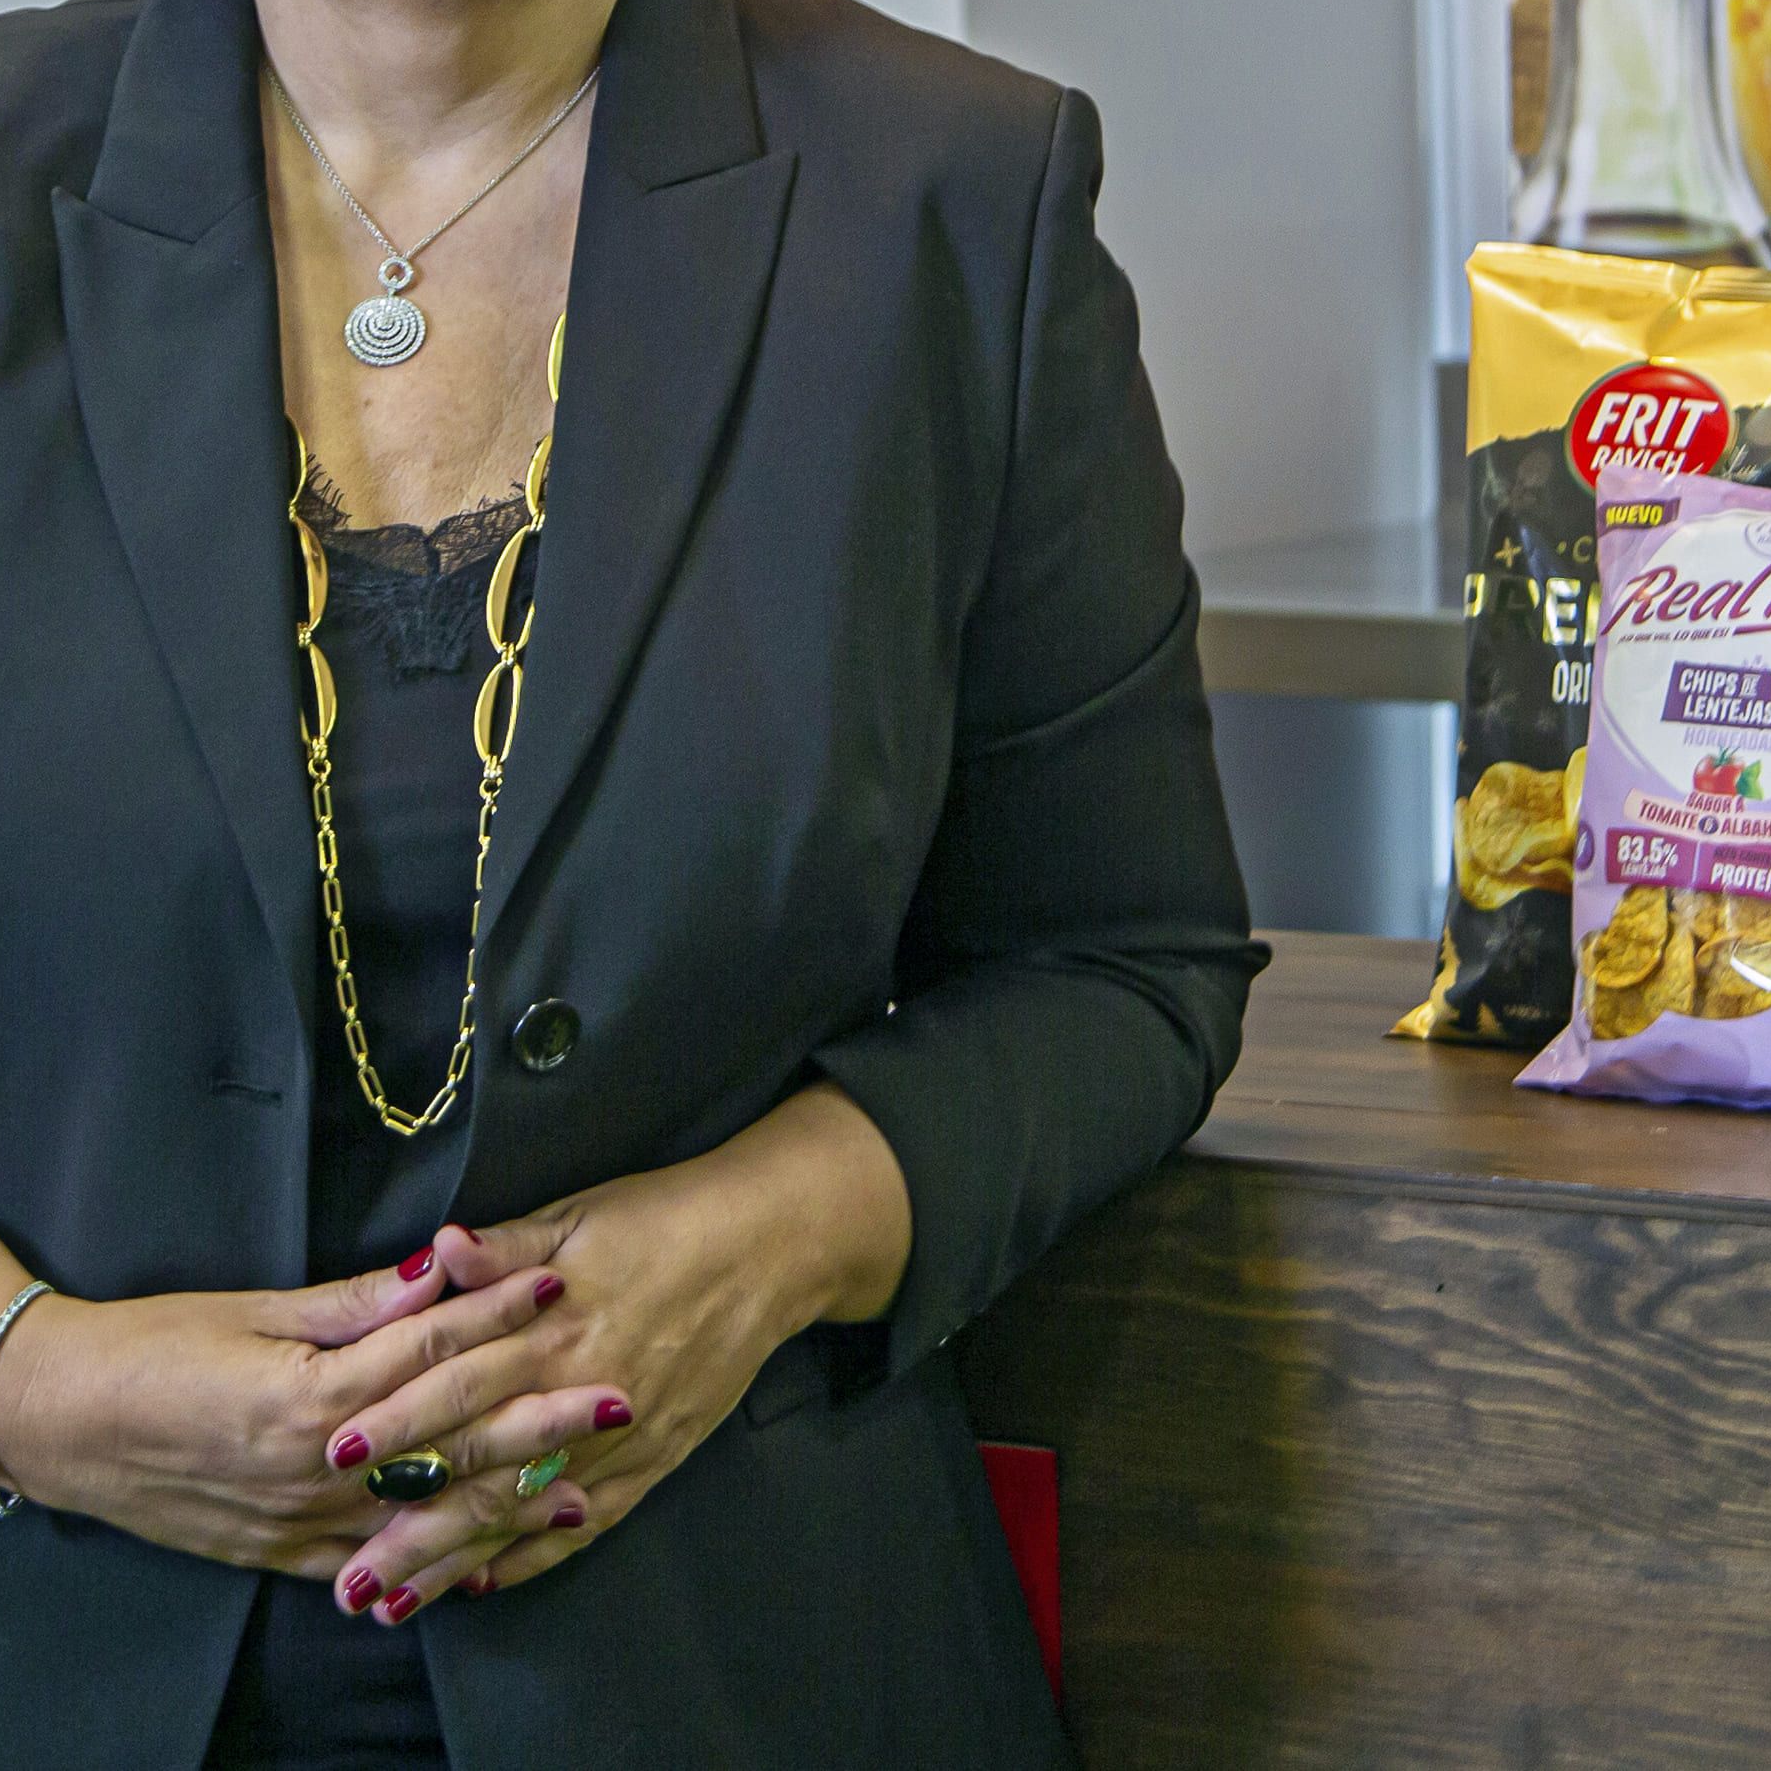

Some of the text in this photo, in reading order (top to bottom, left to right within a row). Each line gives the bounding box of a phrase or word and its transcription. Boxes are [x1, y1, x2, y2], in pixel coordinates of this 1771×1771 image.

[1586, 392, 1719, 451] FRIT
[1591, 445, 1687, 480] RAVICH
[1605, 504, 1664, 527] NUEVO
[1679, 668, 1762, 697] CHIPS DE
[1639, 799, 1699, 830] TOMATE
[1685, 791, 1732, 813] SABOR
